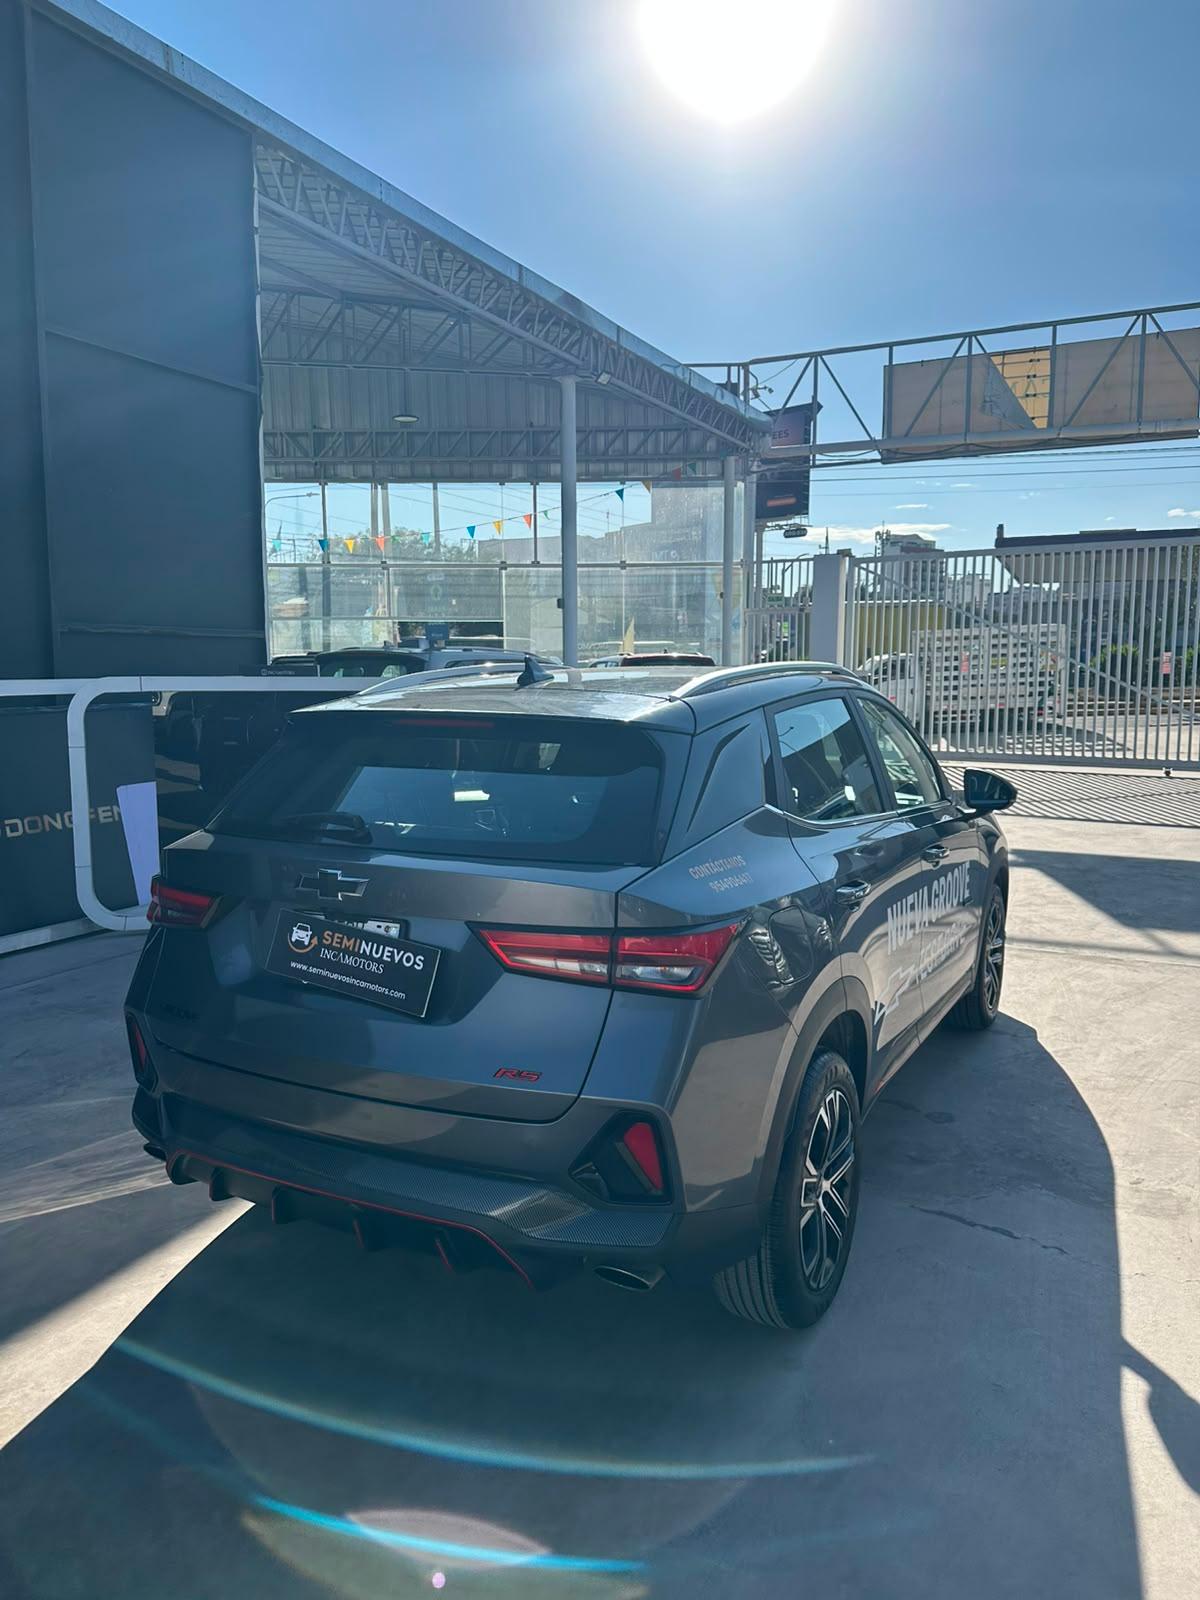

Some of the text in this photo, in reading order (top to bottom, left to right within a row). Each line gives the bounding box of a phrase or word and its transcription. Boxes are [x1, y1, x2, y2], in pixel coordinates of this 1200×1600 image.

[887, 860, 970, 956] NUEVA GROOVE
[319, 947, 385, 975] INCAMOTORS
[322, 929, 425, 971] SEMINUEVOS
[289, 959, 407, 1000] www.seminuevosincamotors.com
[493, 1067, 542, 1082] RS
